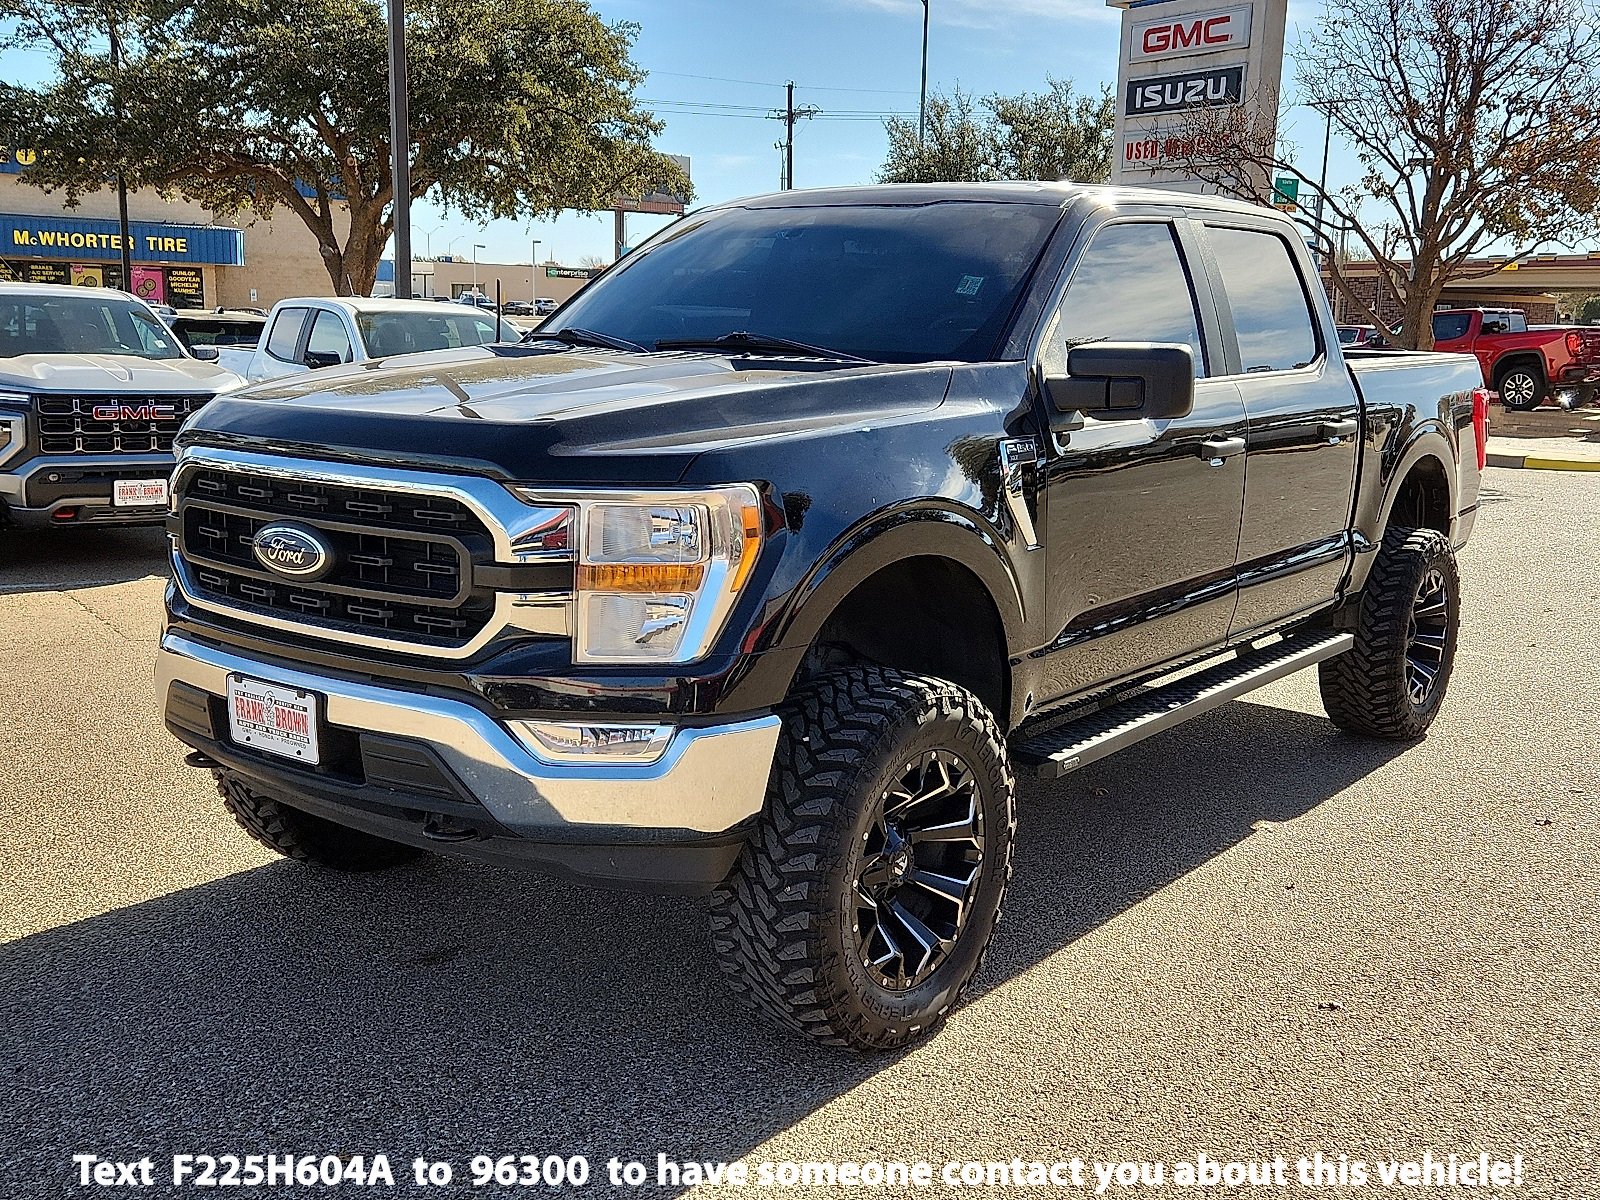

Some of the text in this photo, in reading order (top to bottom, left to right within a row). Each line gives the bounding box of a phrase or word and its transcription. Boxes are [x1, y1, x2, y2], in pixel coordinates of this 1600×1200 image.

[1142, 16, 1231, 53] GMC
[1135, 76, 1227, 109] ISUZU
[1126, 140, 1159, 160] USED
[145, 236, 188, 253] TIRE
[92, 405, 175, 420] GMC
[118, 486, 163, 496] FRANK BROWN
[267, 536, 306, 565] Ford
[234, 696, 309, 737] FRANK BROWN
